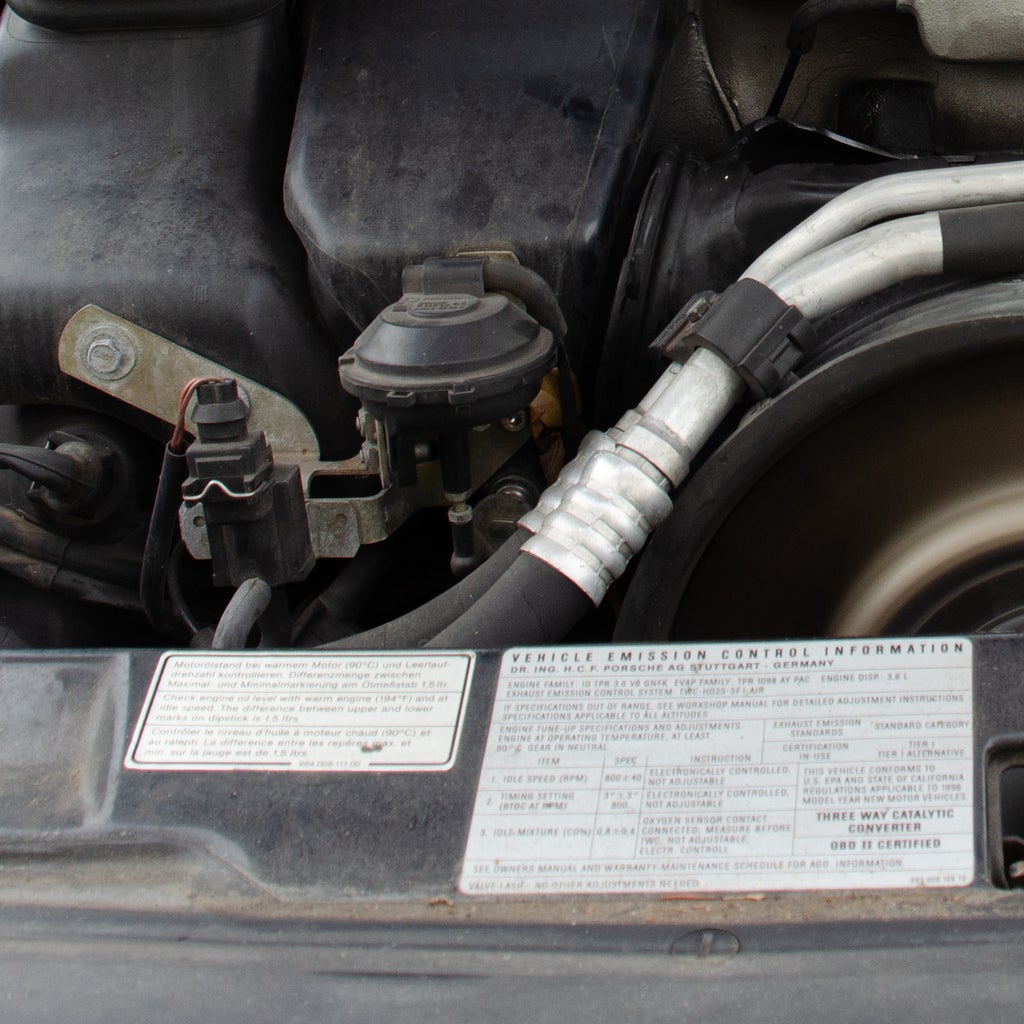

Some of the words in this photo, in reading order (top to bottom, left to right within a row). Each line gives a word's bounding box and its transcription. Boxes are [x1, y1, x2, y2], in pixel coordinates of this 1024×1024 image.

[510, 652, 592, 664] VEHICLE
[607, 649, 706, 661] EMISSION
[721, 647, 810, 659] CONTROL
[824, 643, 963, 656] INFORMATION
[603, 664, 663, 672] PORSCHE
[689, 661, 760, 670] STUTTGART
[772, 660, 834, 668] GERMANY
[507, 681, 540, 689] ENGINE
[820, 674, 854, 682] ENGINE
[505, 690, 544, 699] EXHAUST
[546, 689, 591, 698] EMISSION
[593, 688, 635, 697] CONTROL
[513, 703, 584, 712] SPECIFICATIONS
[586, 702, 604, 710] OUT
[656, 701, 673, 709] SEE
[676, 700, 728, 708] WORKSHOP
[730, 699, 768, 707] MANUAL
[771, 698, 789, 706] FOR
[792, 697, 834, 706] DETAILED
[836, 696, 896, 705] ADJUSTMENT
[899, 694, 964, 703] INSTRUCTIONS
[501, 713, 572, 722] SPECIFICATIONS
[573, 712, 626, 720] APPLICABLE
[661, 710, 708, 718] ALTITUDES
[498, 726, 533, 734] ENGINE
[578, 723, 650, 732] SPECIFICATIONS
[652, 722, 672, 730] AND
[773, 720, 813, 728] EXHAUST
[815, 719, 861, 727] EMISSION
[874, 721, 921, 730] STANDARD
[547, 734, 597, 742] OPERATING
[684, 731, 710, 739] LEAST
[790, 729, 843, 737] STANDARDS
[567, 742, 607, 751] NEUTRAL
[782, 743, 849, 751] CERTIFICATION
[906, 749, 964, 757] ALTERNATIVE
[614, 756, 637, 764] SPEC
[690, 754, 751, 763] INSTRUCTION
[648, 767, 725, 776] ELECTRONICALLY
[803, 767, 824, 775] THIS
[827, 766, 865, 774] VEHICLE
[868, 765, 921, 773] CONFORMS
[502, 776, 523, 784] IDLE
[526, 775, 556, 783] SPEED
[647, 778, 666, 786] NOT
[668, 777, 725, 785] ADJUSTABLE
[844, 776, 864, 784] AND
[910, 774, 964, 782] CALIFORNIA
[802, 786, 867, 794] REGULATIONS
[869, 785, 923, 793] APPLICABLE
[500, 793, 534, 801] TIMING
[536, 792, 575, 800] SETTING
[802, 796, 834, 804] MODEL
[837, 796, 860, 804] YEAR
[863, 795, 885, 803] NEW
[887, 794, 919, 802] MOTOR
[642, 816, 681, 825] OXYGEN
[684, 815, 723, 824] SENSOR
[725, 814, 767, 823] CONTACT
[816, 811, 854, 820] THREE
[860, 811, 887, 819] WAY
[892, 809, 953, 818] CATALYTIC
[705, 825, 750, 833] MEASURE
[848, 822, 921, 832] CONVERTER
[830, 841, 856, 850] OBD
[877, 839, 940, 849] CERTIFIED
[492, 864, 535, 874] OWNERS
[537, 863, 577, 873] MANUAL
[733, 859, 784, 868] SCHEDULE
[787, 858, 806, 867] FOR
[835, 856, 902, 866] INFORMATION
